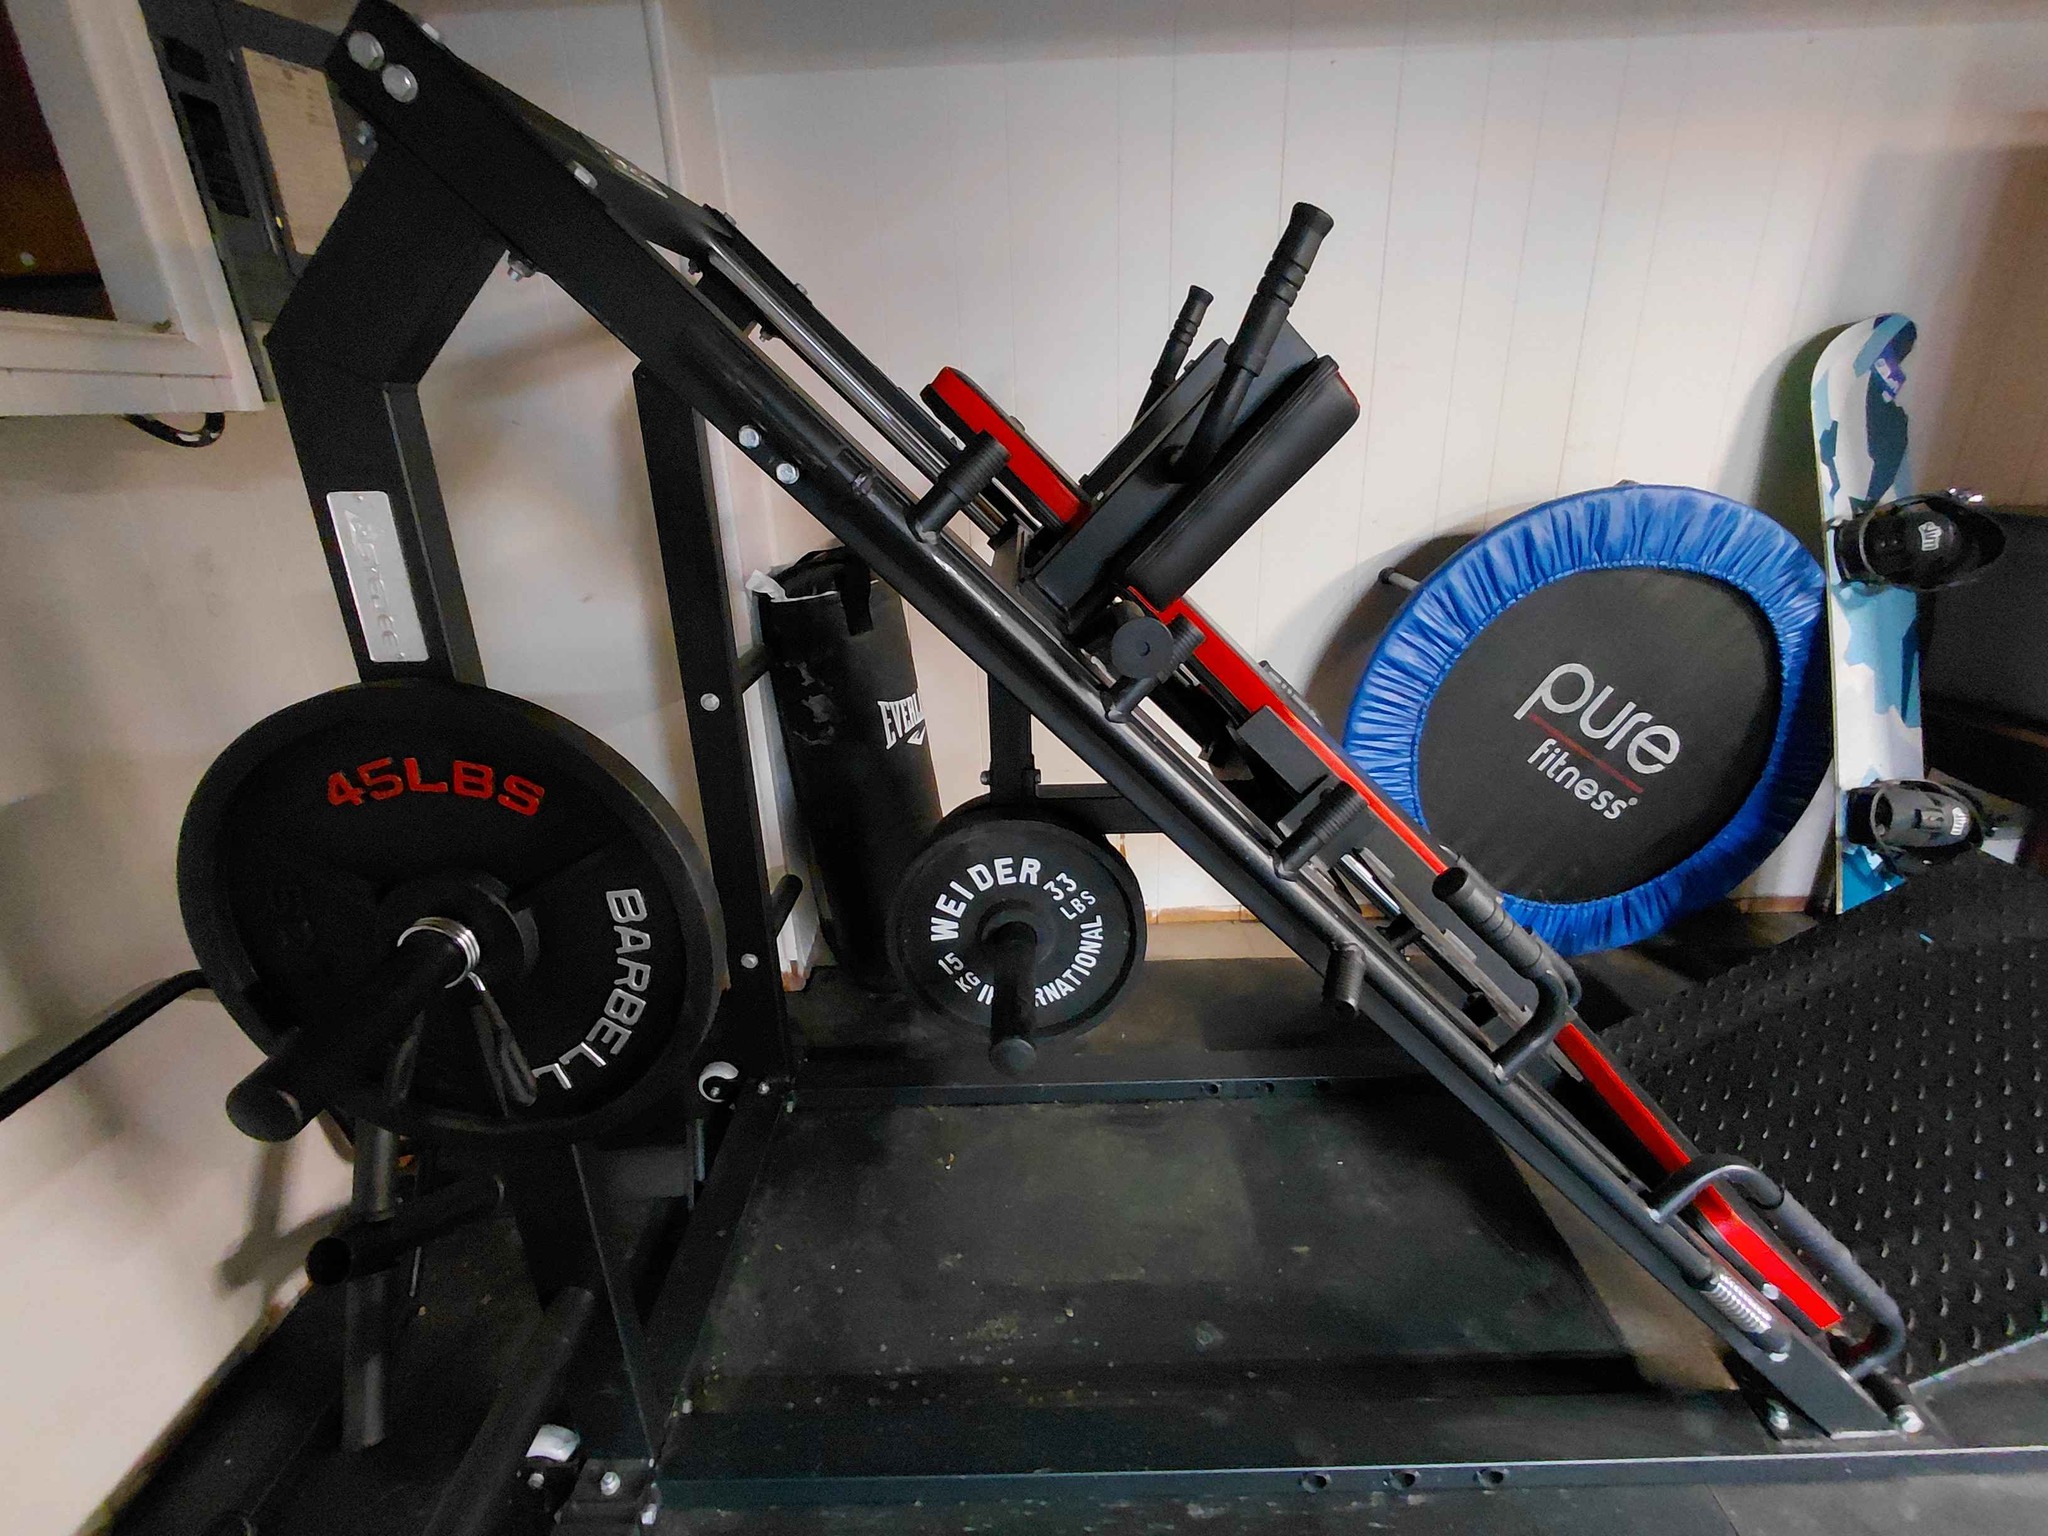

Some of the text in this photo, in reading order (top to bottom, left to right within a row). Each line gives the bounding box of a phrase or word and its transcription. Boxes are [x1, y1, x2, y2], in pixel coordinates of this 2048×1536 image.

[877, 692, 925, 750] EVERL
[1513, 663, 1680, 774] pure
[1527, 738, 1628, 820] fitness
[930, 857, 1042, 941] WEIDER
[1043, 872, 1077, 901] 33
[1059, 890, 1096, 920] LBS
[532, 888, 651, 1089] BARBELL
[938, 953, 963, 975] 15
[955, 971, 981, 993] KG
[977, 915, 1104, 1007] IRNATIONAL
